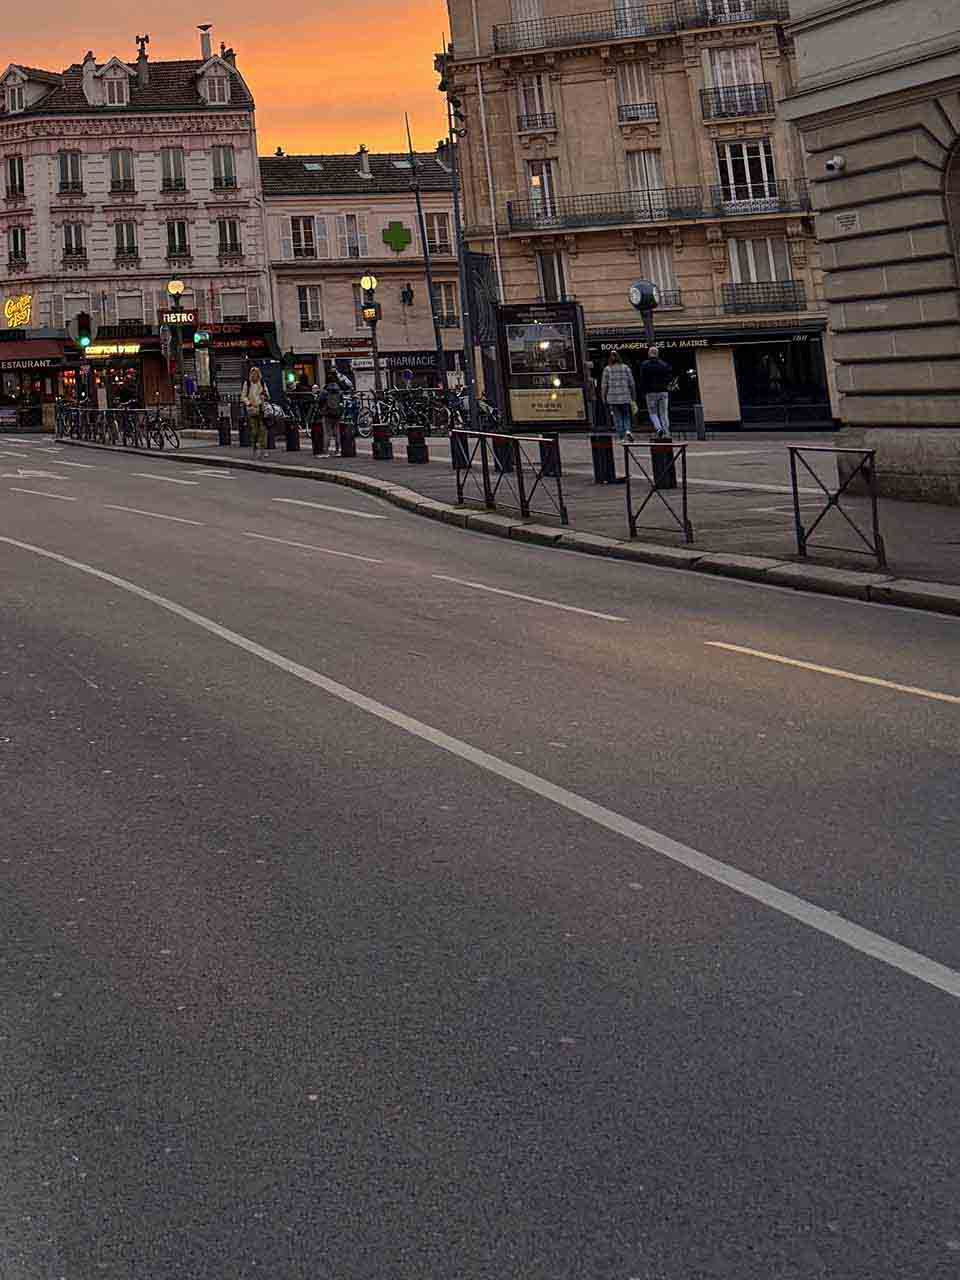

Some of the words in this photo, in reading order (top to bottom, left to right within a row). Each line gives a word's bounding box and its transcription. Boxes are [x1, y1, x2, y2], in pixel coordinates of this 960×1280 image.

[600, 342, 649, 351] BOULANGERI
[666, 340, 677, 348] LA
[679, 339, 709, 348] MAIRIE
[385, 354, 436, 367] PHARMACIE
